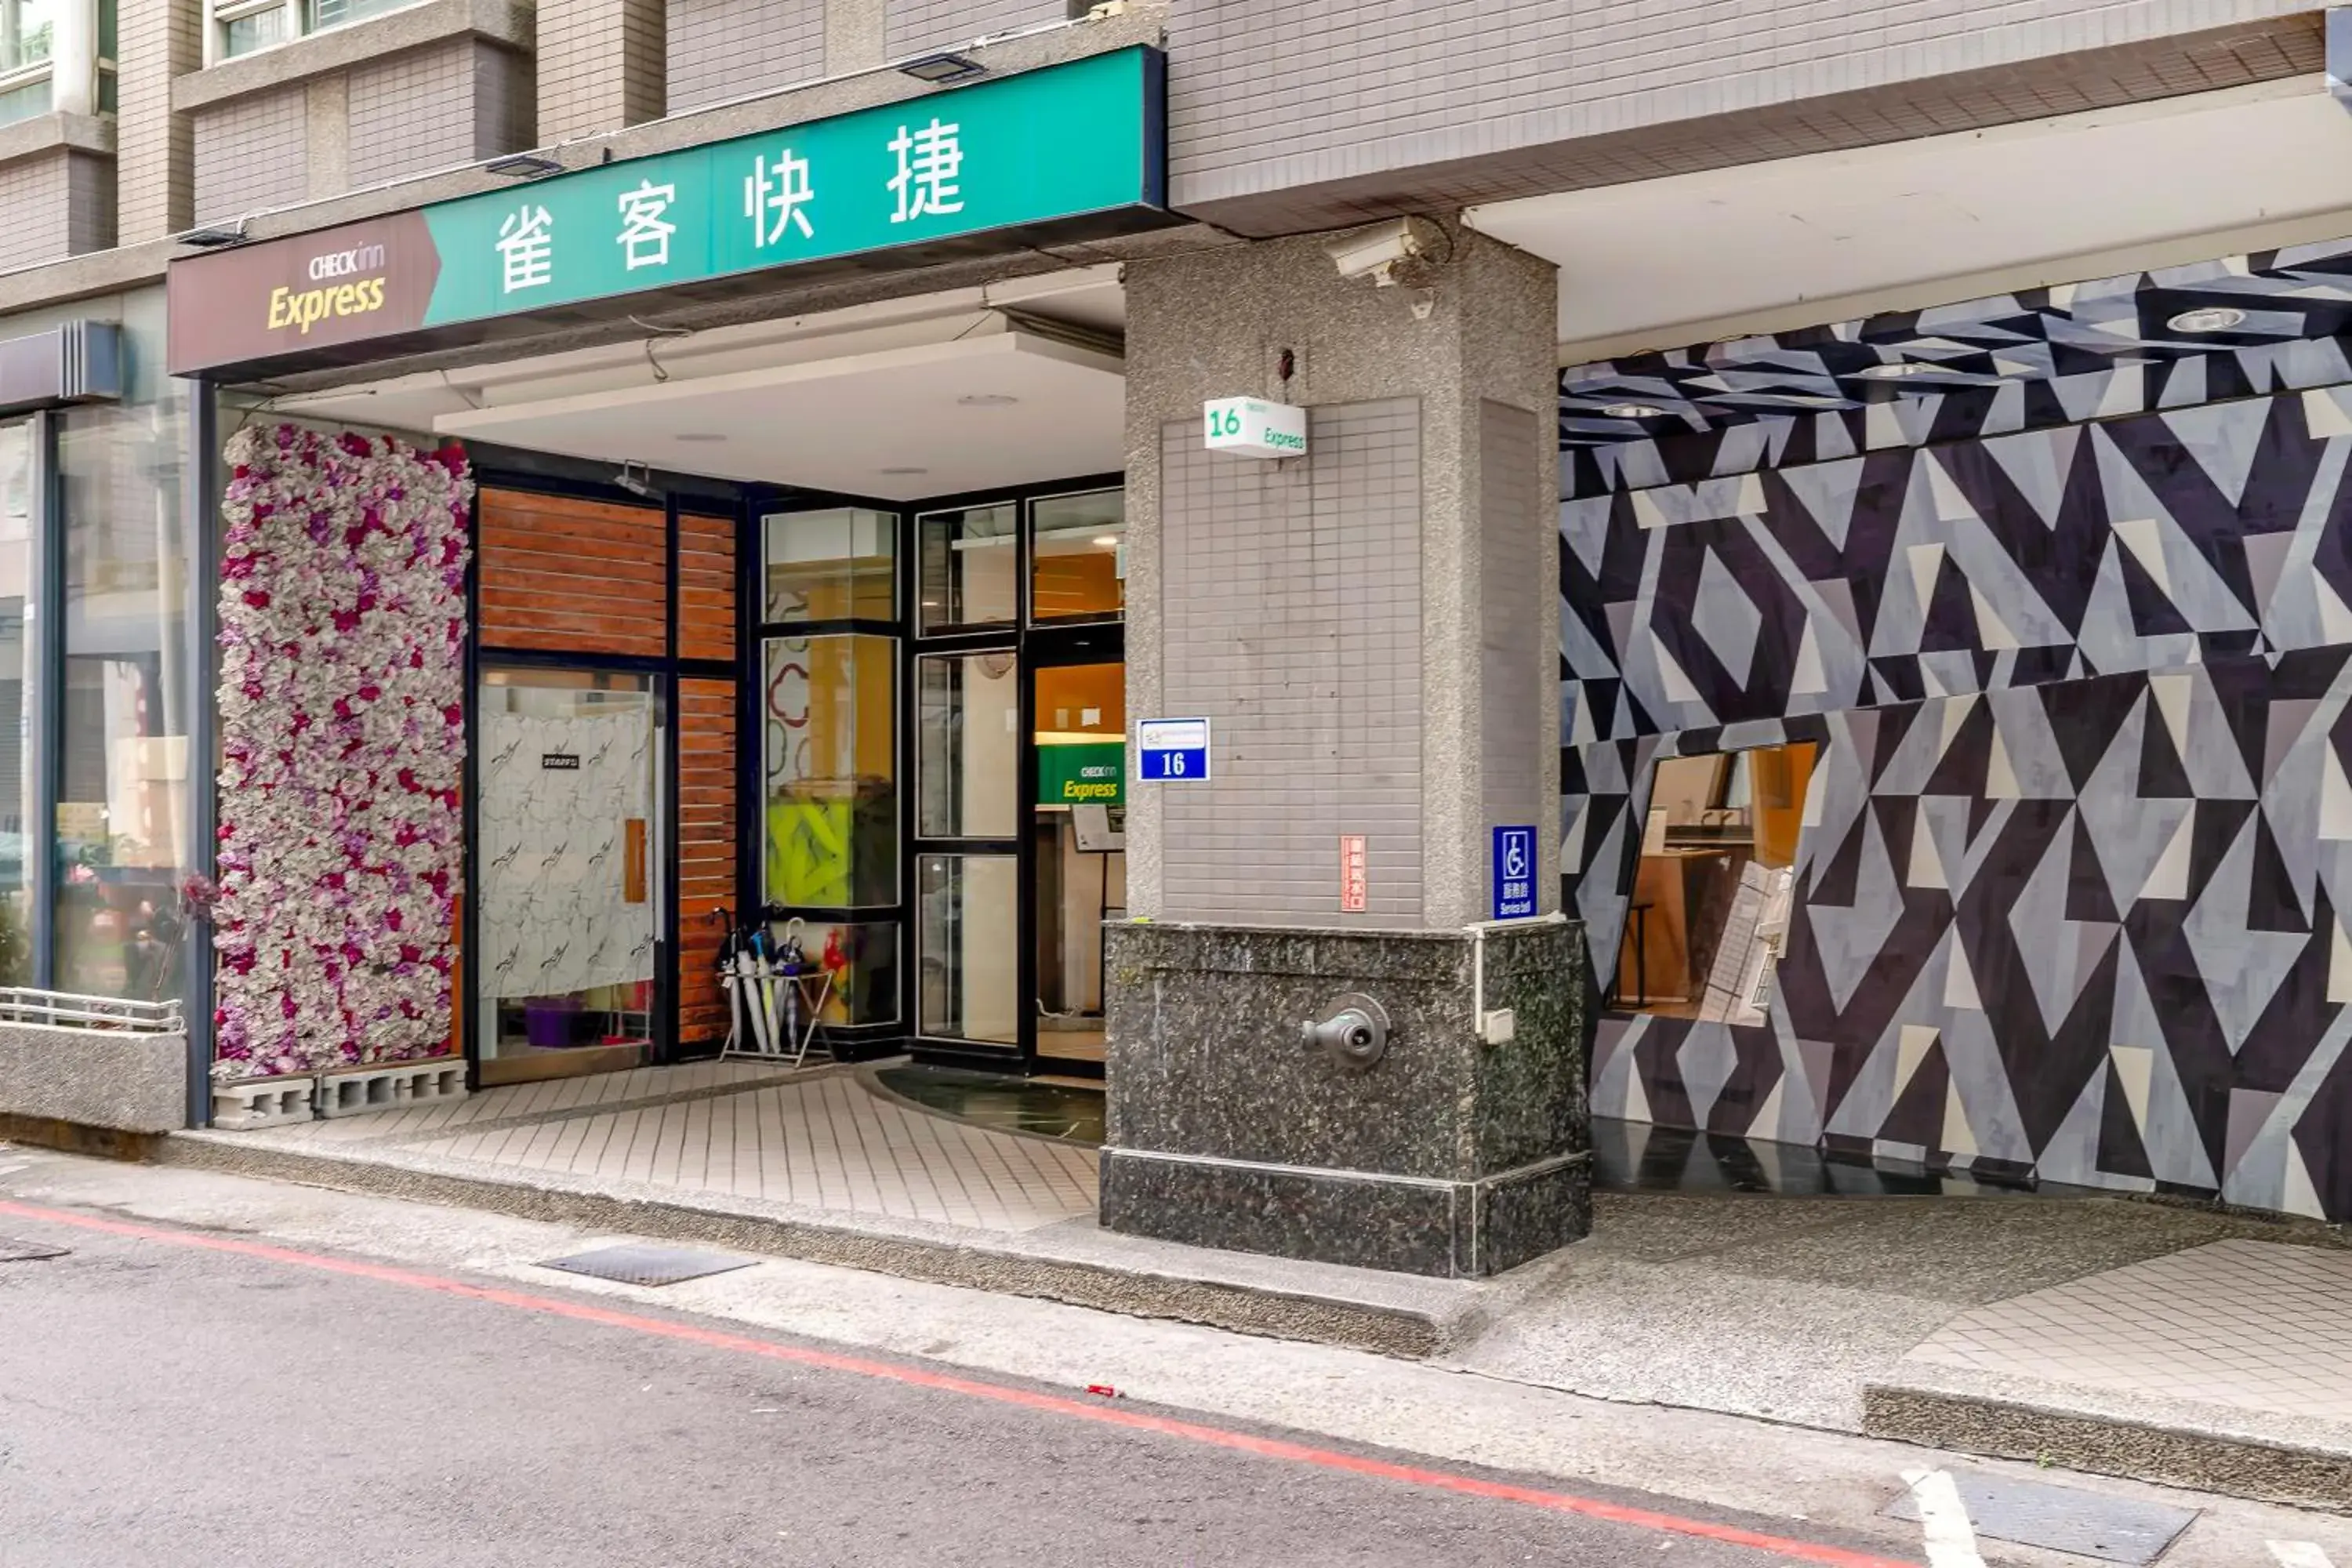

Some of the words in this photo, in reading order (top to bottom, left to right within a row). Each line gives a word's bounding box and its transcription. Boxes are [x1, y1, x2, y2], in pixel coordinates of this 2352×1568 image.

[495, 118, 964, 294] 雀客快捷
[267, 276, 385, 334] Express
[1210, 408, 1240, 437] 16
[1265, 427, 1304, 450] Express
[1162, 752, 1185, 775] 16
[1064, 780, 1116, 801] Express
